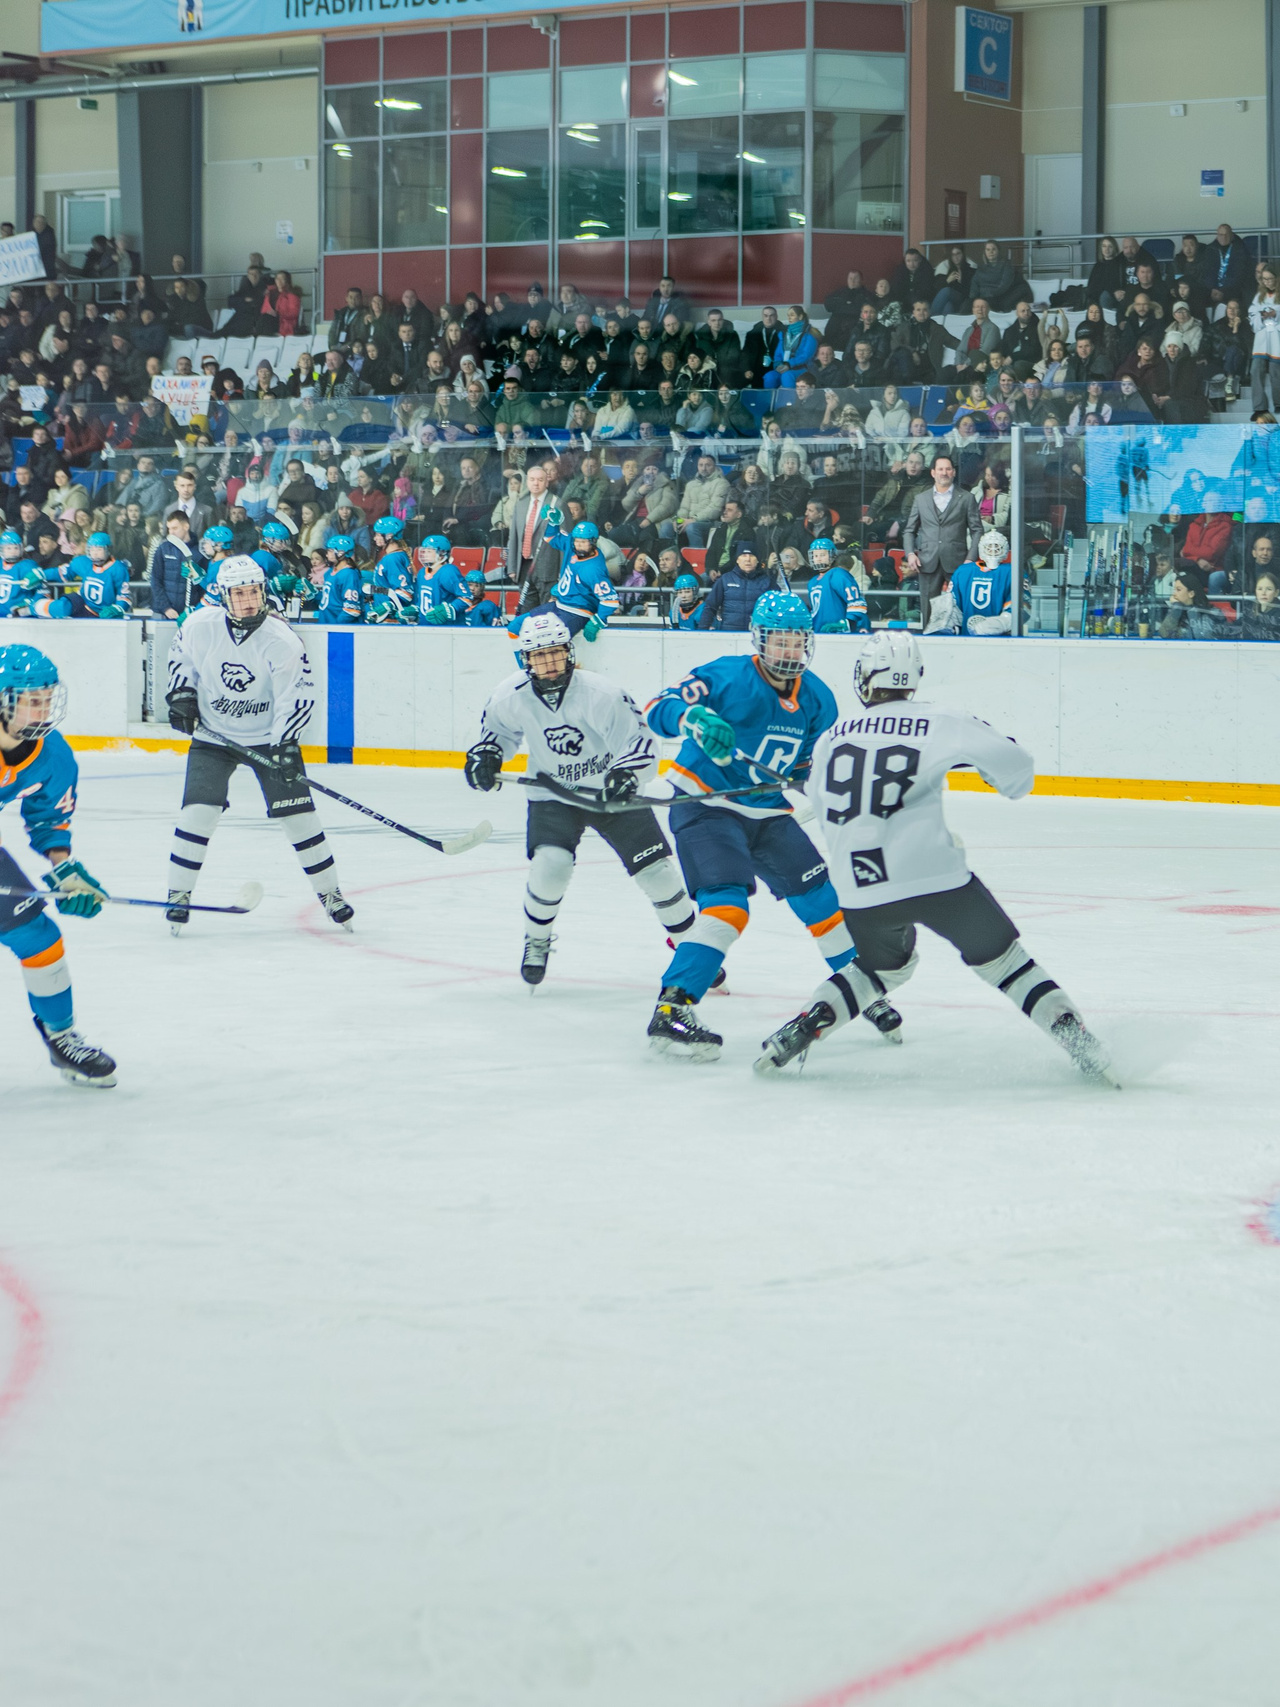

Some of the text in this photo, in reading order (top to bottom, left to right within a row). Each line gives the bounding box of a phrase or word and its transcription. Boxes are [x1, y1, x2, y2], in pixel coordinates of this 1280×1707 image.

[594, 581, 611, 596] 43
[845, 586, 859, 601] 17
[892, 672, 909, 686] 98
[826, 742, 921, 826] 98
[272, 796, 312, 810] BAUER
[633, 843, 664, 863] CCM
[13, 896, 38, 916] CC
